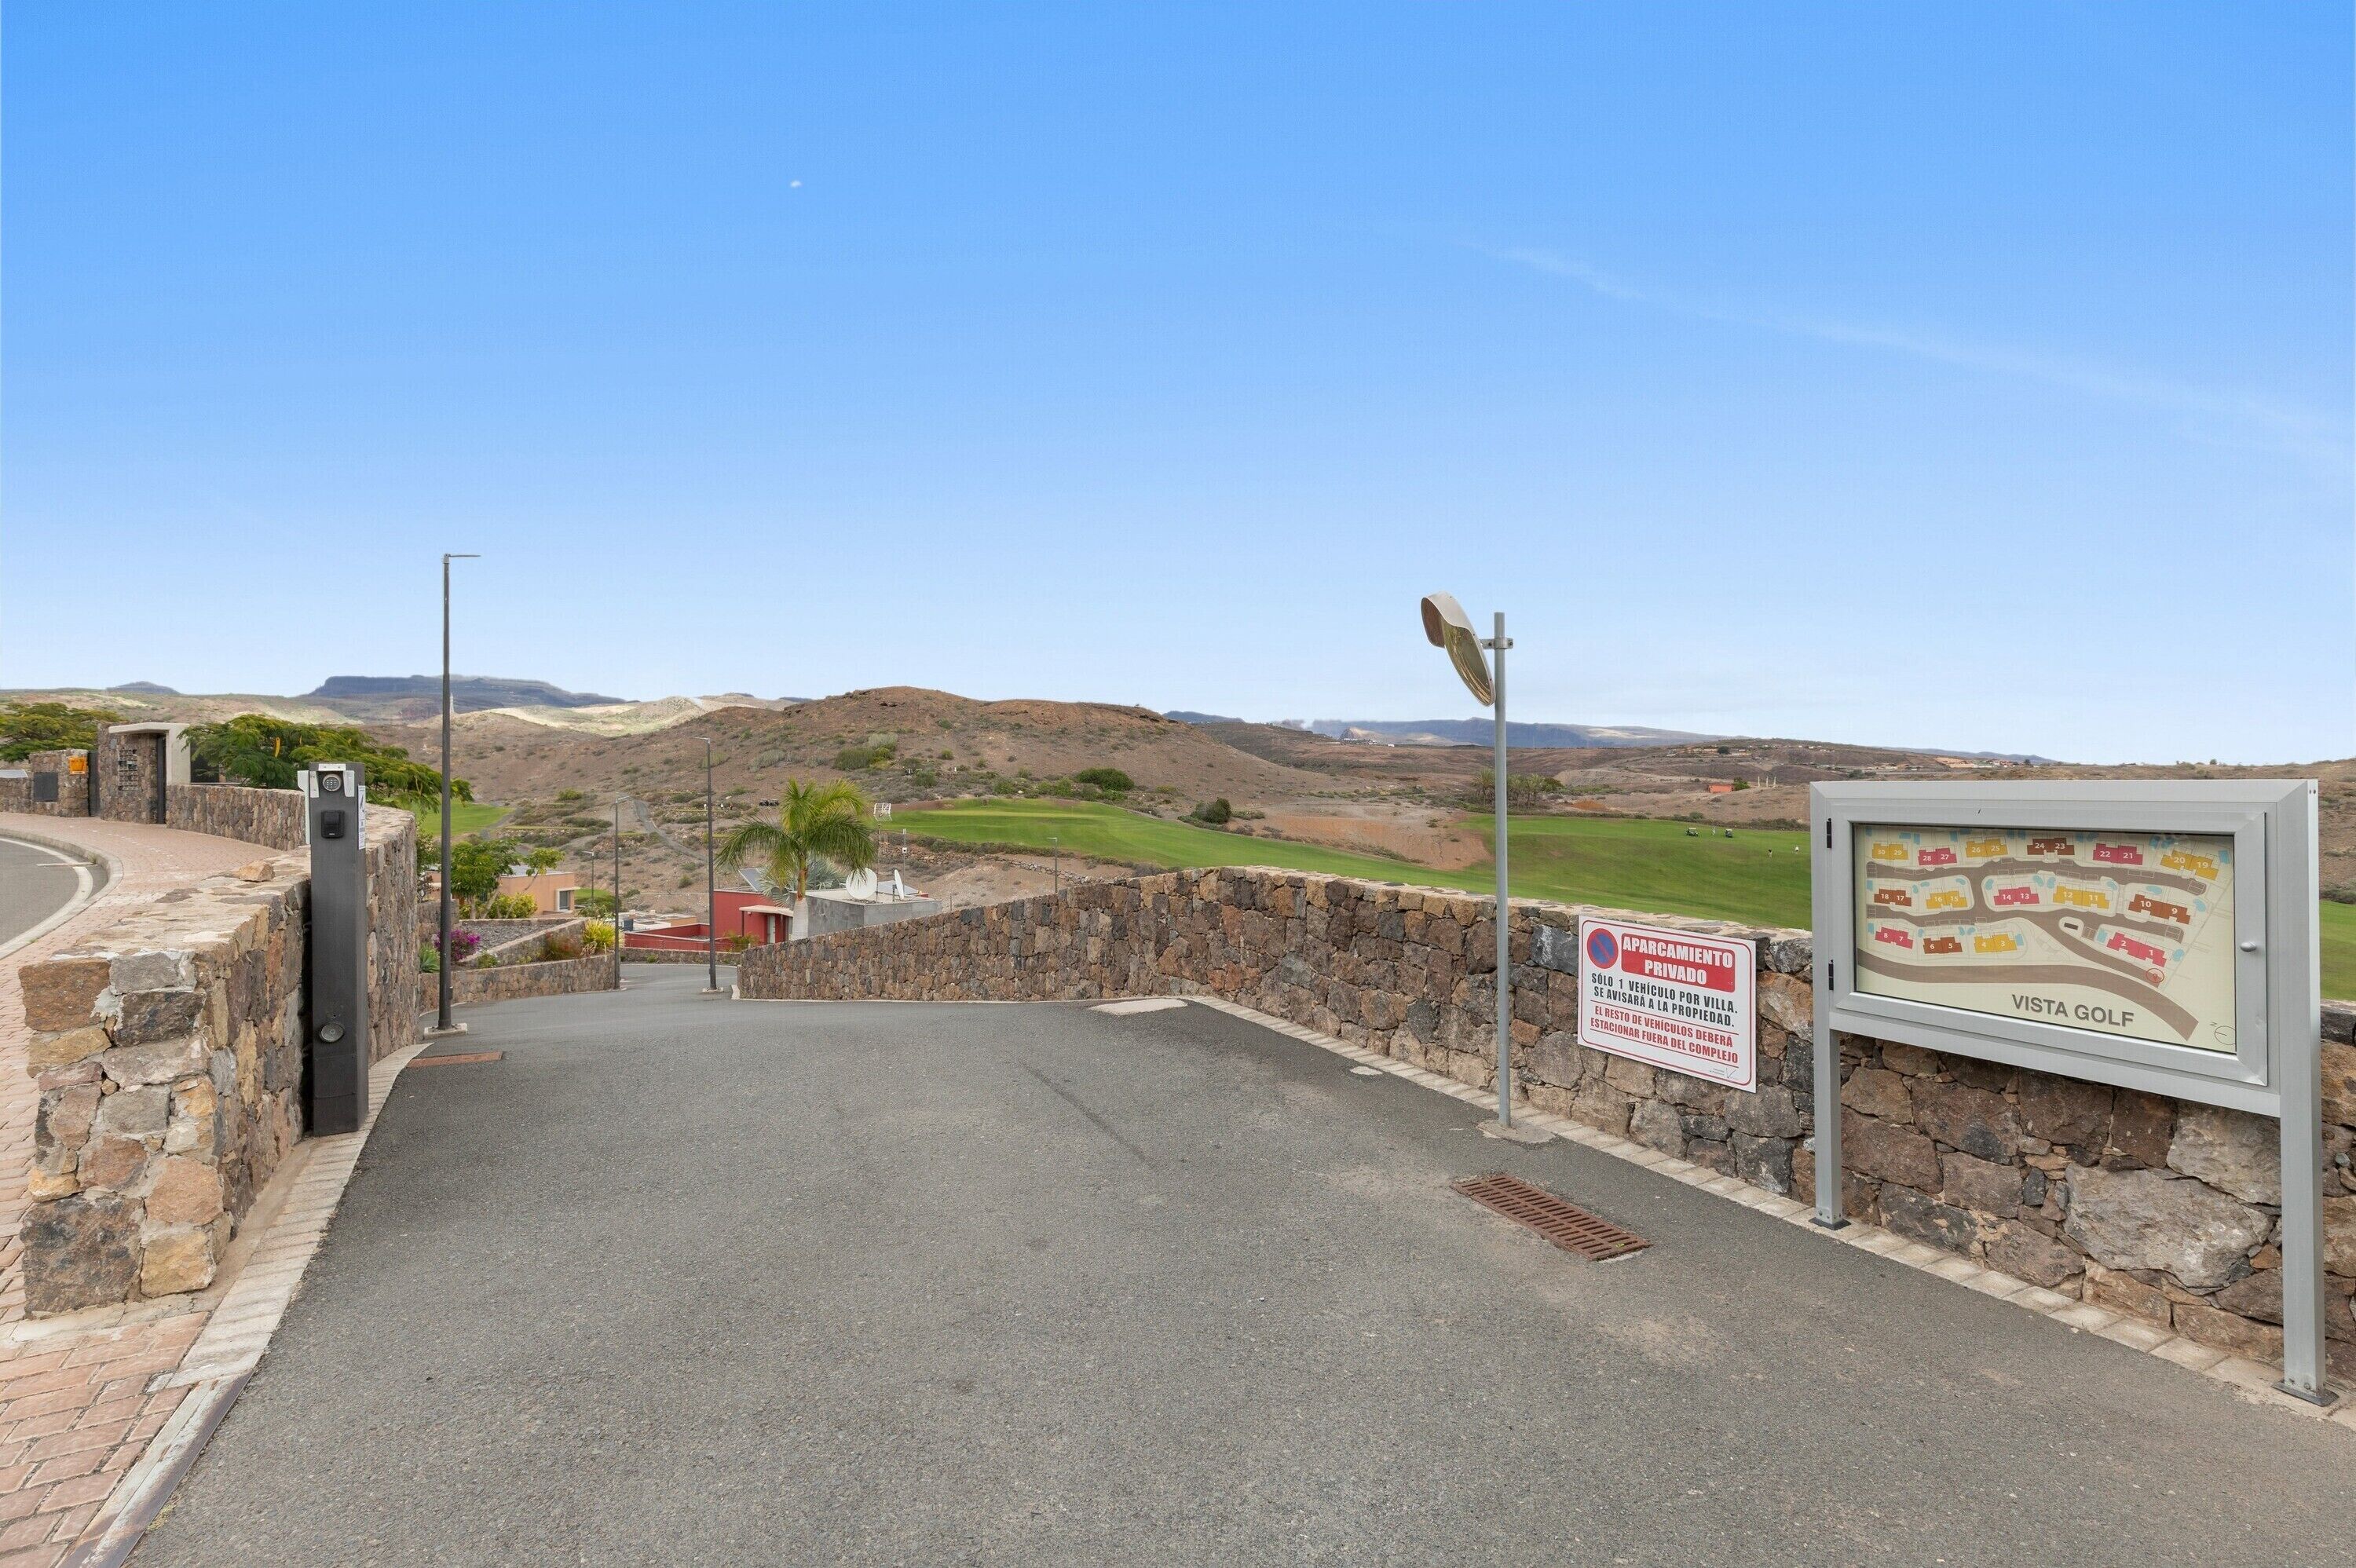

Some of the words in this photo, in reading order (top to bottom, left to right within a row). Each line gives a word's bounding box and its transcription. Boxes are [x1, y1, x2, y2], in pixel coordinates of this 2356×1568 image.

[1622, 936, 1732, 968] APARCAMIENTO
[1644, 959, 1707, 985] PRIVADO
[1591, 972, 1613, 987] SÓLO
[1619, 978, 1622, 989] 1
[1629, 980, 1675, 1000] VEHÍCULO
[1680, 991, 1699, 1005] POR
[1703, 996, 1737, 1014] VILLA.
[1594, 986, 1604, 997] SE
[1607, 989, 1645, 1007] AVISARÁ
[1648, 998, 1654, 1009] A
[1657, 1000, 1668, 1012] LA
[1672, 1003, 1734, 1027] PROPIEDAD.
[2012, 993, 2069, 1018] VISTA
[2074, 1003, 2135, 1027] GOLF
[1590, 1018, 1639, 1038] ESTACIONAR
[1642, 1030, 1668, 1046] FUERA
[1670, 1038, 1686, 1051] DEL
[1688, 1042, 1738, 1063] COMPLEJO
[1595, 1005, 1603, 1015] EL
[1605, 1008, 1630, 1022] RESTO
[1632, 1014, 1642, 1025] DE
[1644, 1018, 1693, 1037] VEHÍCULOS
[1696, 1029, 1732, 1047] DEBERÁ
